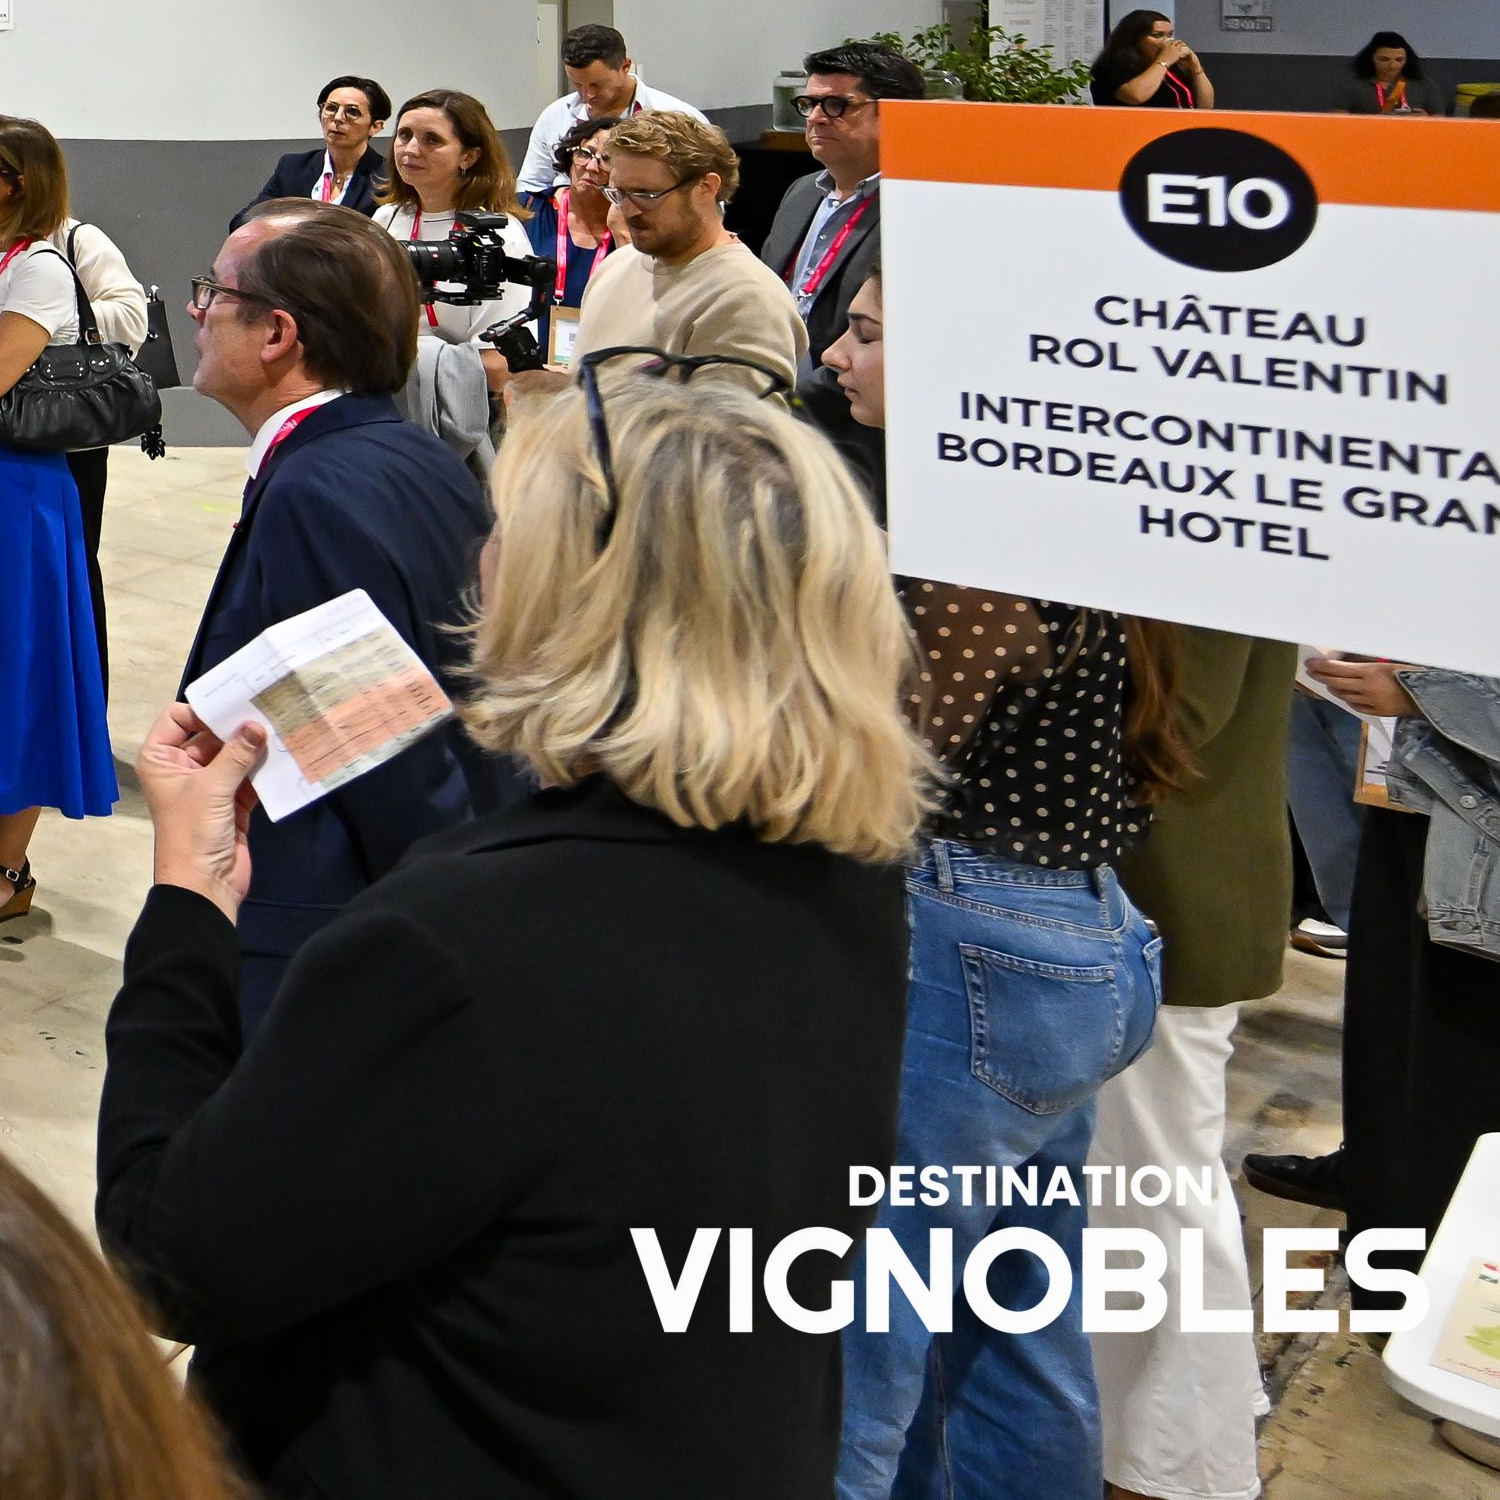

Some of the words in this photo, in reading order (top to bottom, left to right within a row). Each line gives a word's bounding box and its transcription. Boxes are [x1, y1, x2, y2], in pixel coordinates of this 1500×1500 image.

[1146, 171, 1292, 231] E10
[1093, 295, 1367, 348] CHÂTEAU
[1028, 334, 1138, 375] ROL
[1152, 344, 1449, 406] VALENTIN
[959, 390, 1500, 483] INTERCONTINENTA
[937, 431, 1236, 501] BORDEAUX
[1255, 472, 1325, 512] LE
[1139, 503, 1330, 561] HOTEL
